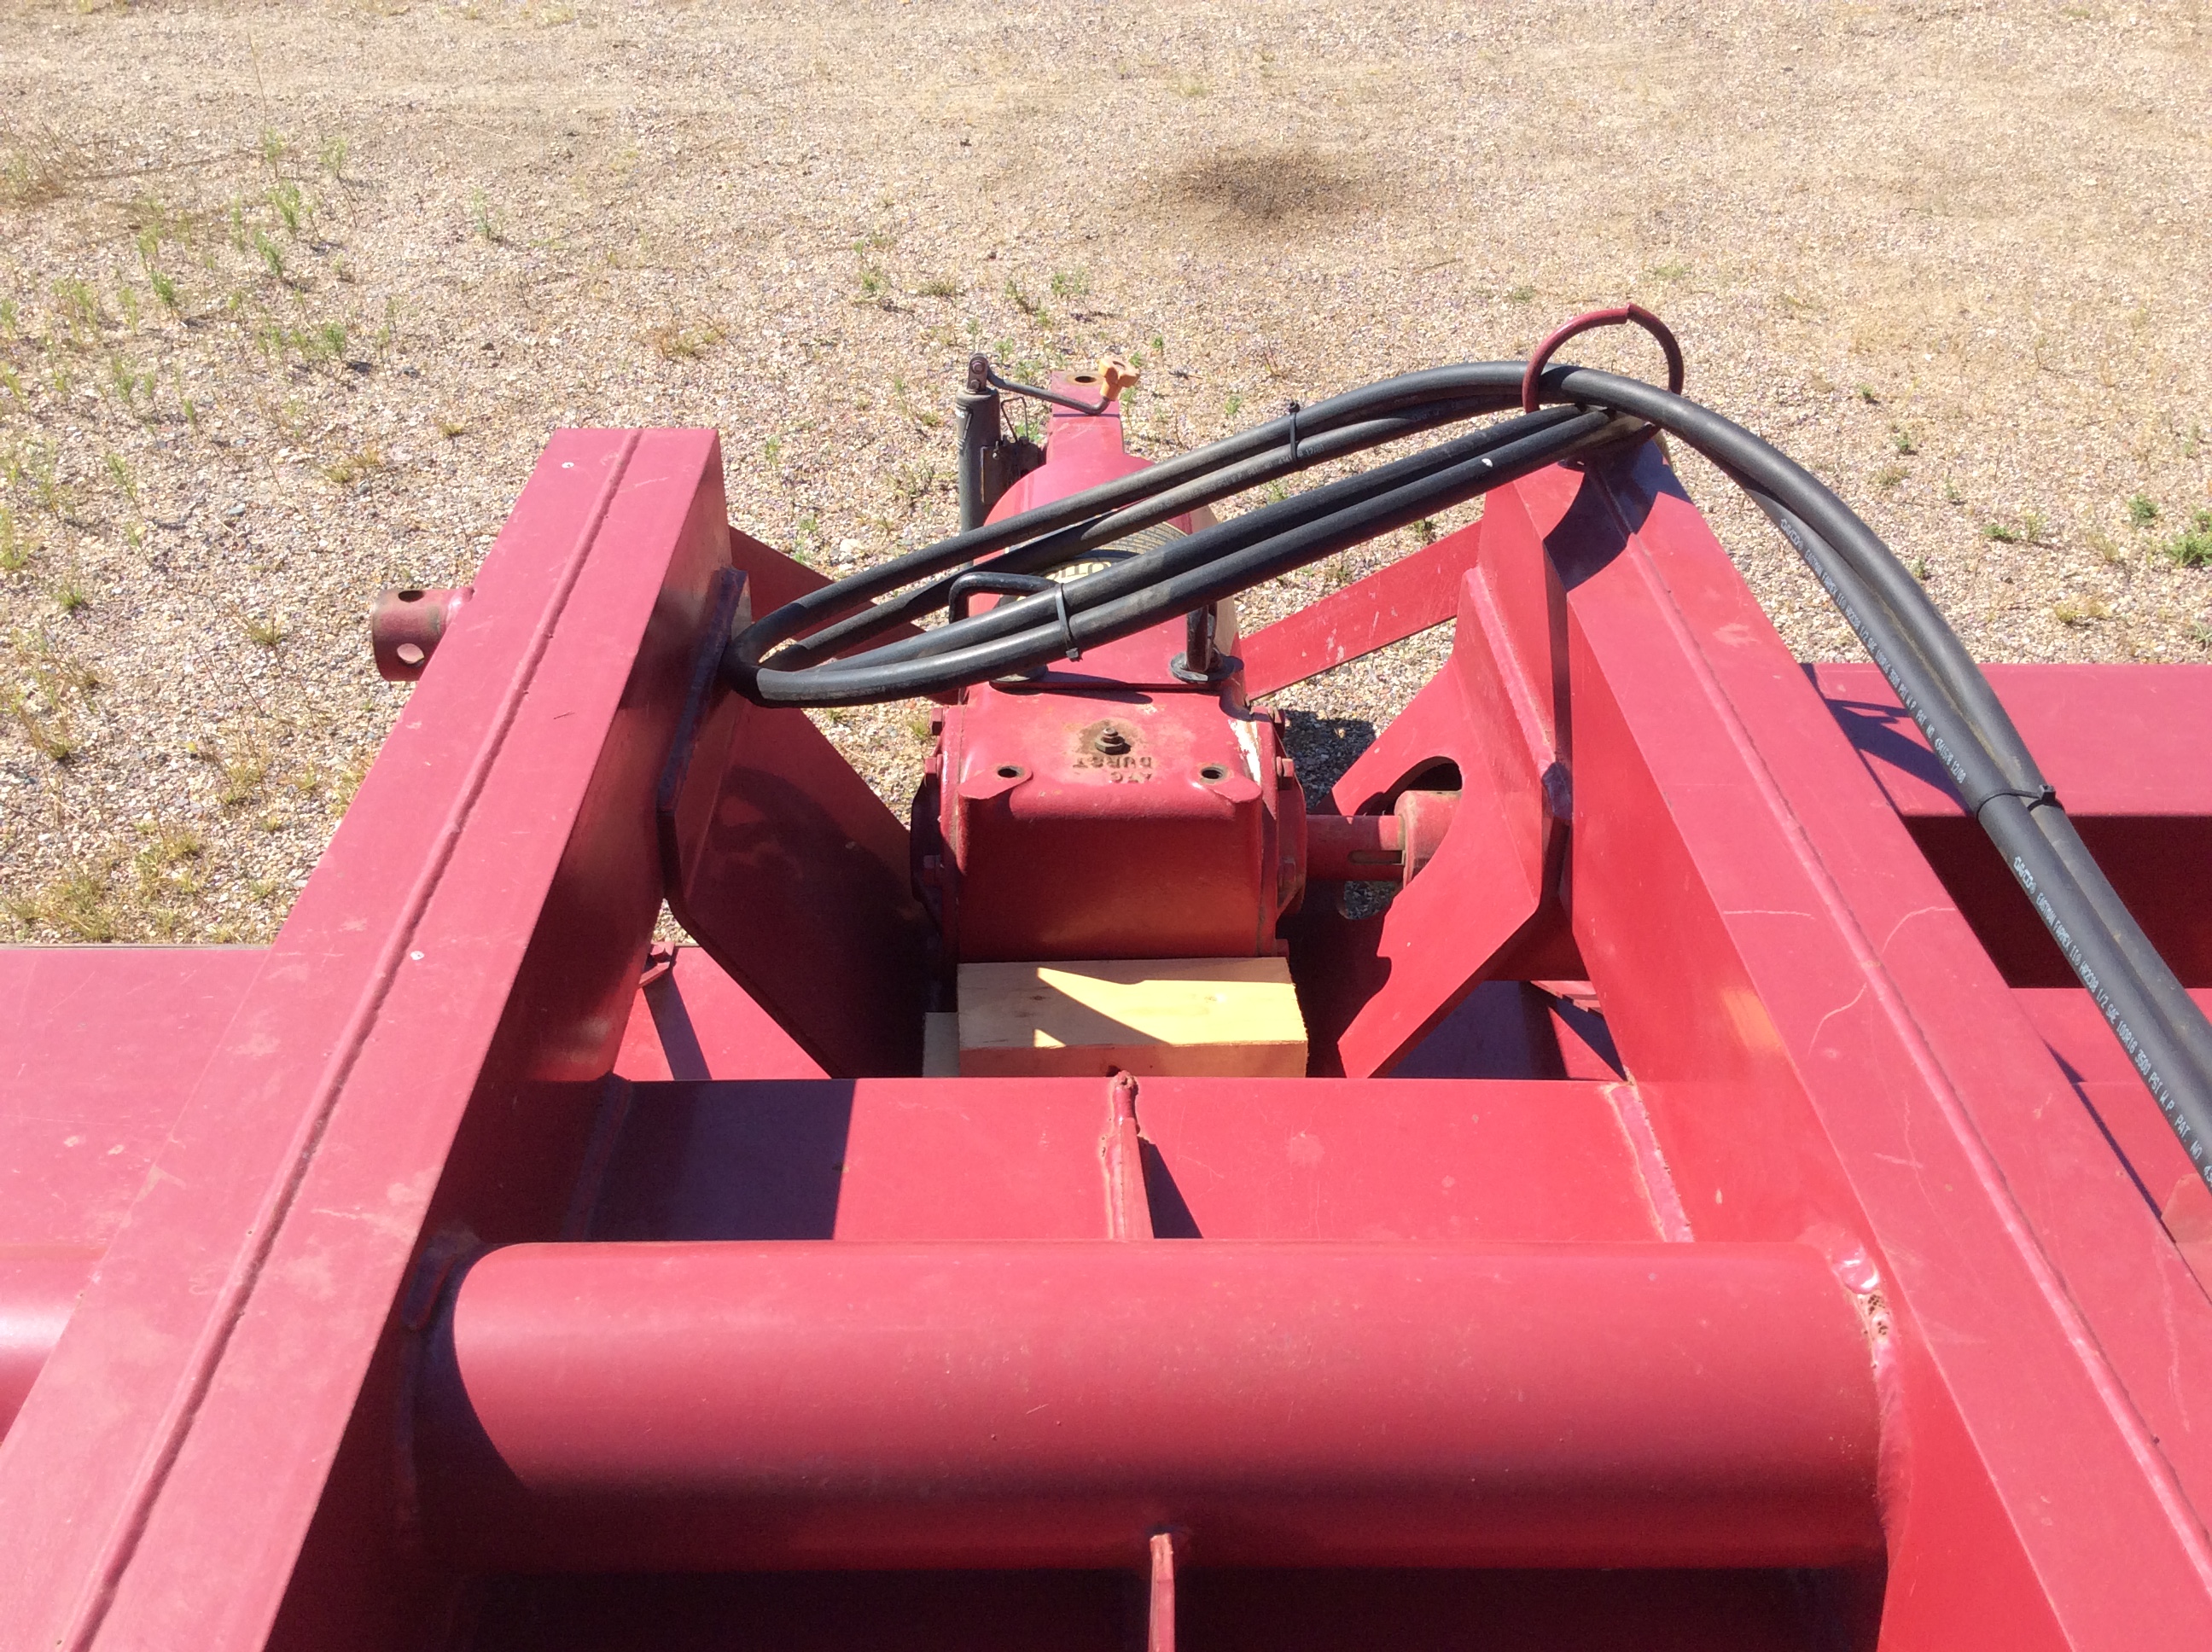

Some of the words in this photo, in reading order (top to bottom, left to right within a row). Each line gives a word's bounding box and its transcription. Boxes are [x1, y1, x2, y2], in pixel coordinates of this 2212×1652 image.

[1073, 756, 1151, 768] DURST
[2036, 892, 2057, 927] EASTMAN
[2096, 989, 2109, 1009] 1/2
[2105, 1004, 2121, 1024] SAE
[2116, 1021, 2138, 1055] 100R16
[2134, 1049, 2151, 1076] 3500
[2148, 1072, 2163, 1095] PSI
